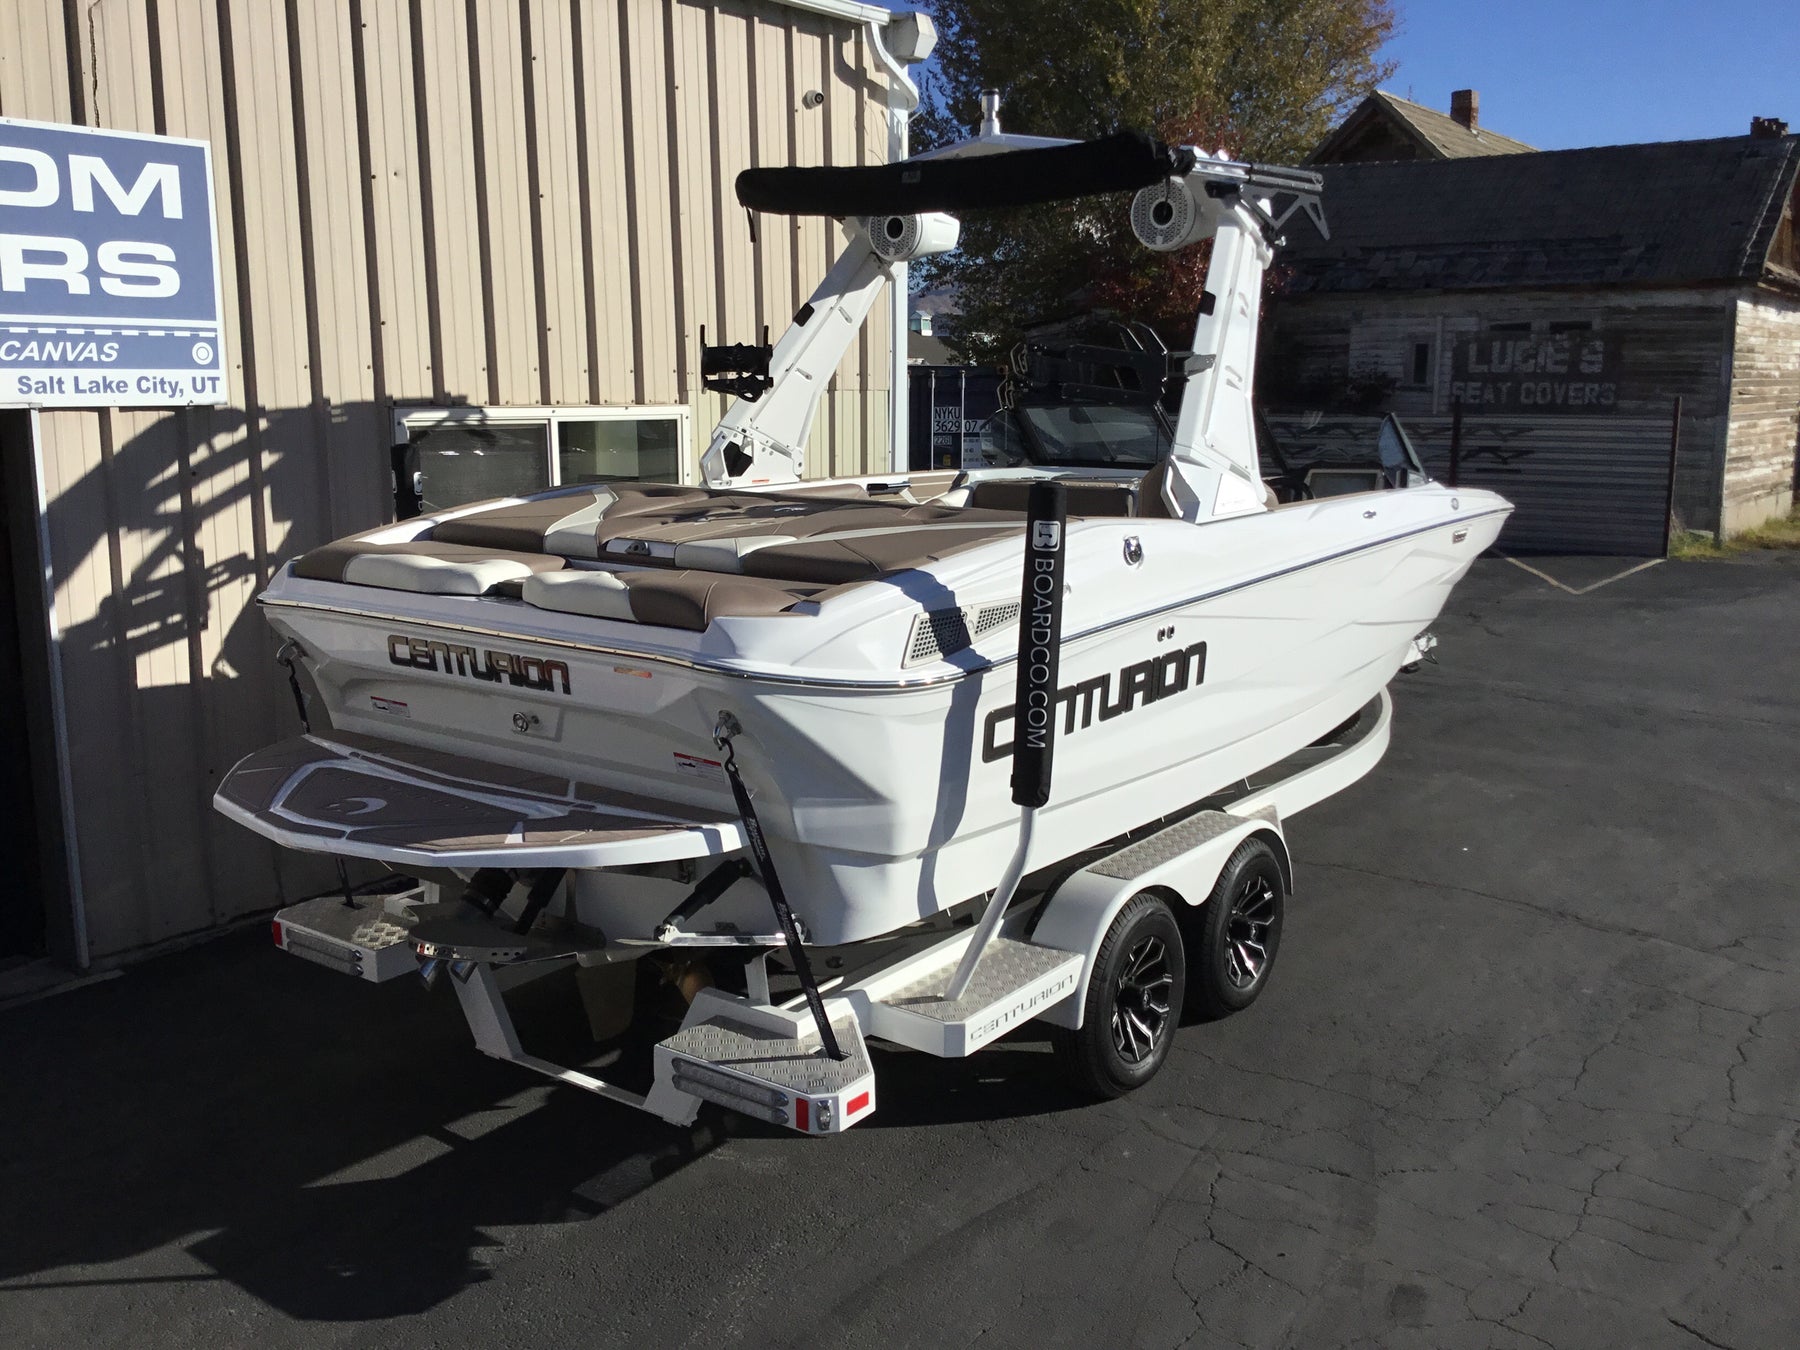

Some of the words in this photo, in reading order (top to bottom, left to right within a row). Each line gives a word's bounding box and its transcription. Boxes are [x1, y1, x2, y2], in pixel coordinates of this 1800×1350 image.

[0, 234, 181, 298] RS
[0, 340, 119, 362] CANVAS
[17, 375, 66, 395] Salt
[74, 375, 129, 395] Lake
[136, 376, 184, 398] City,
[191, 376, 220, 394] UT
[934, 407, 960, 419] NYKU
[1452, 381, 1512, 405] SEAT
[1519, 381, 1617, 405] COVERS
[387, 634, 571, 695] CENTURION
[1027, 558, 1055, 748] BOARDCO.COM
[981, 641, 1208, 763] CNTURION
[970, 974, 1073, 1041] CENTURION
